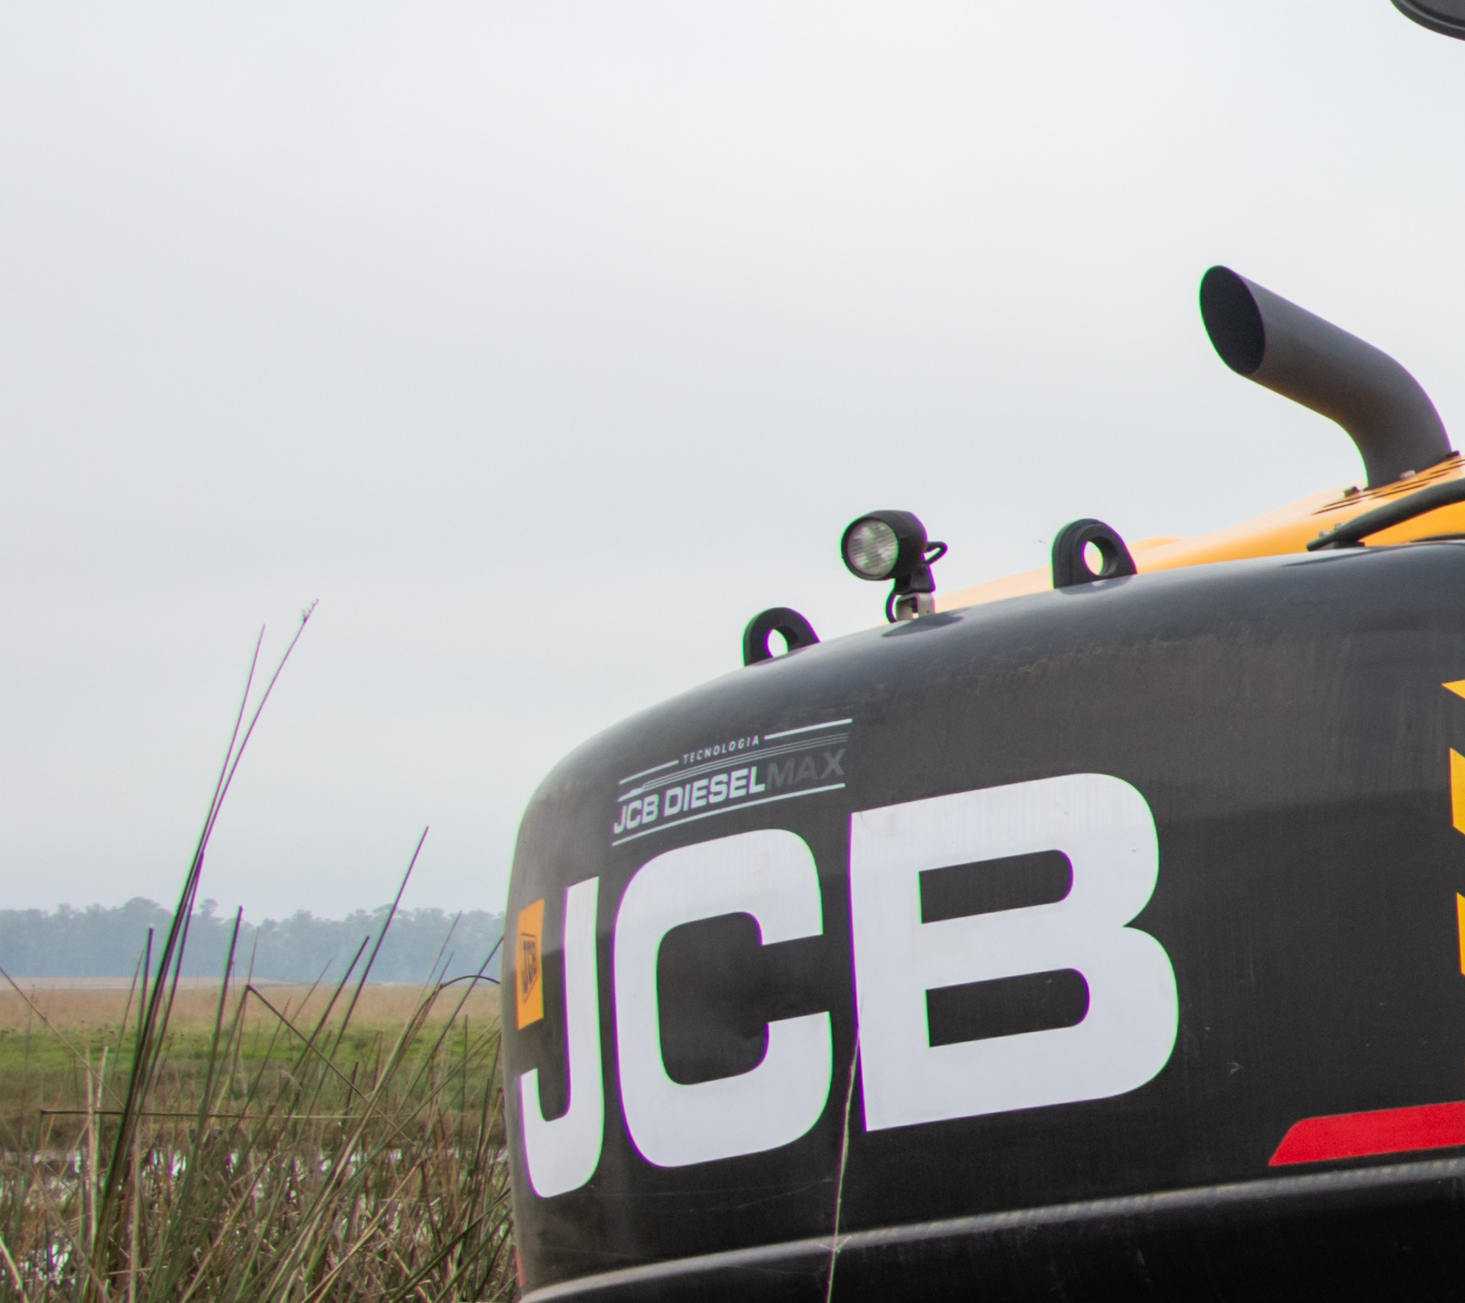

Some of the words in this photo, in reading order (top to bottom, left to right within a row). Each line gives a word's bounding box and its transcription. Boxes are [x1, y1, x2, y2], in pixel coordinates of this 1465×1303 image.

[683, 734, 760, 765] TECNOLOGIA
[612, 793, 660, 835] JCB
[520, 773, 1180, 1200] JCB
